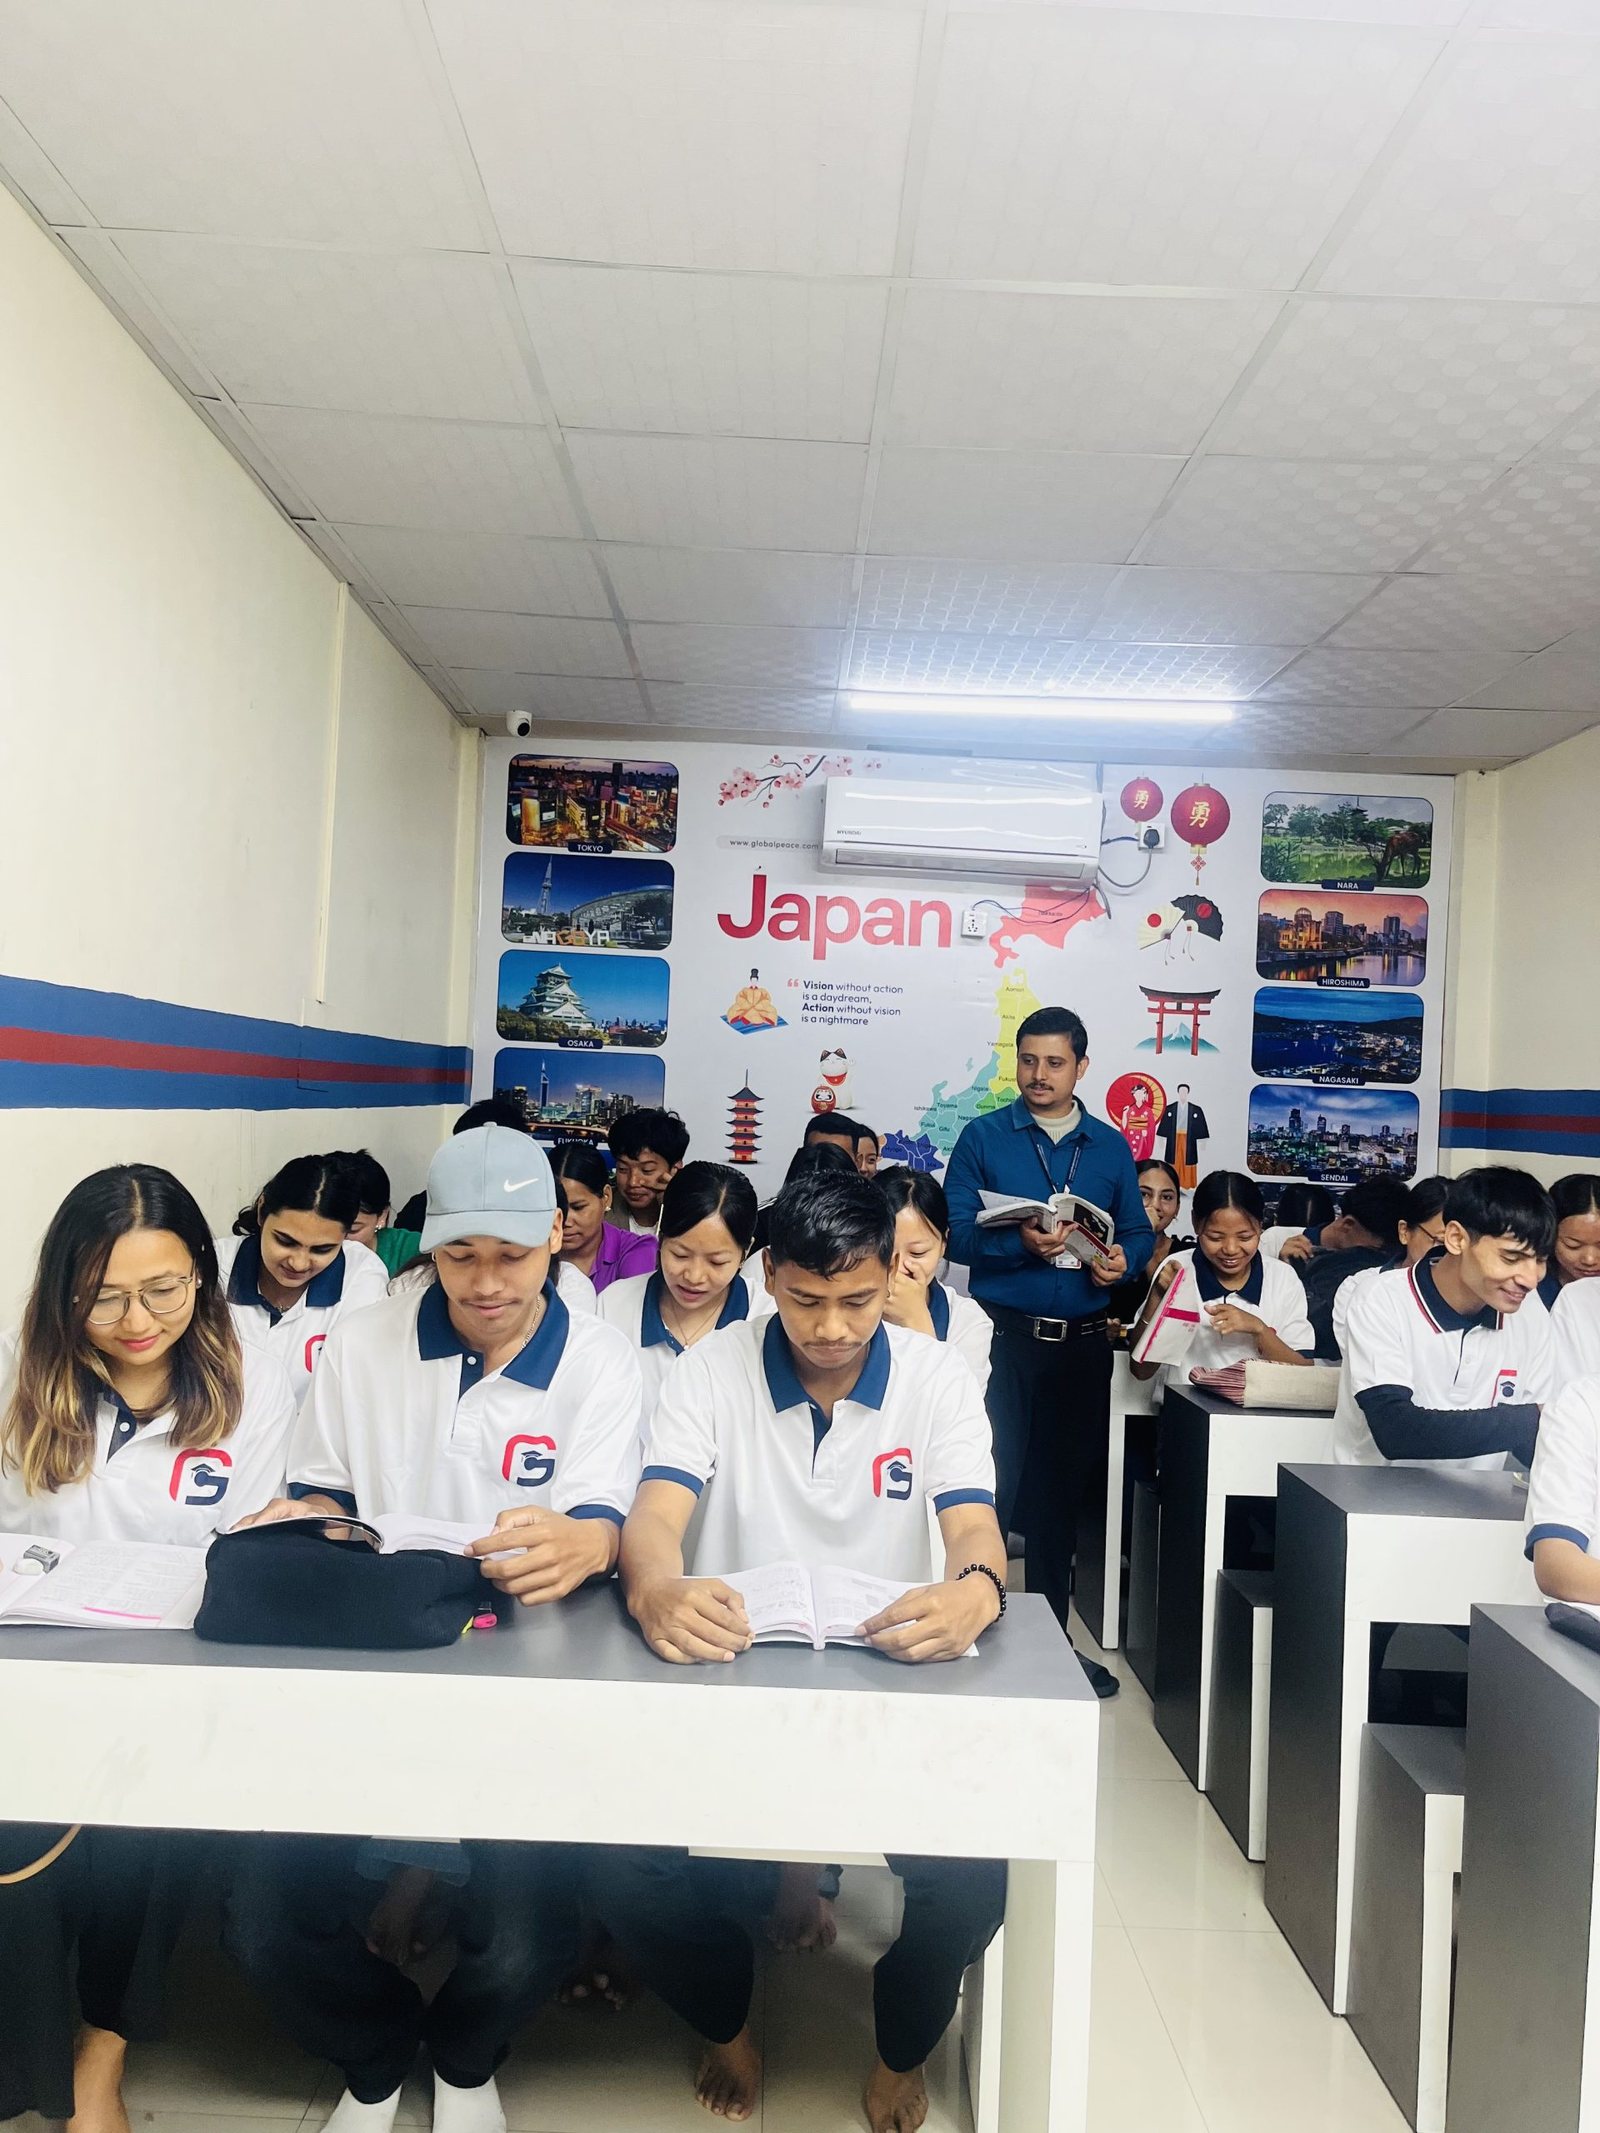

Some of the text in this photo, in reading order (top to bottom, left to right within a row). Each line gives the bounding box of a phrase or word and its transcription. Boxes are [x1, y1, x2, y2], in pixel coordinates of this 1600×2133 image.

[1189, 801, 1211, 828] 勇
[577, 843, 604, 853] TOKYO
[1337, 882, 1359, 890] NARA
[717, 874, 952, 960] Japan
[803, 980, 904, 994] Vision without action
[1322, 978, 1365, 987] HIROSHIMA
[802, 992, 810, 1001] is
[820, 994, 872, 1005] daydream,
[802, 1003, 901, 1016] Action without vision
[801, 1014, 869, 1026] is a nightmare
[567, 1039, 594, 1048] OSAKA
[1319, 1076, 1359, 1085] NAGASAKI
[1320, 1173, 1348, 1181] SENDAI
